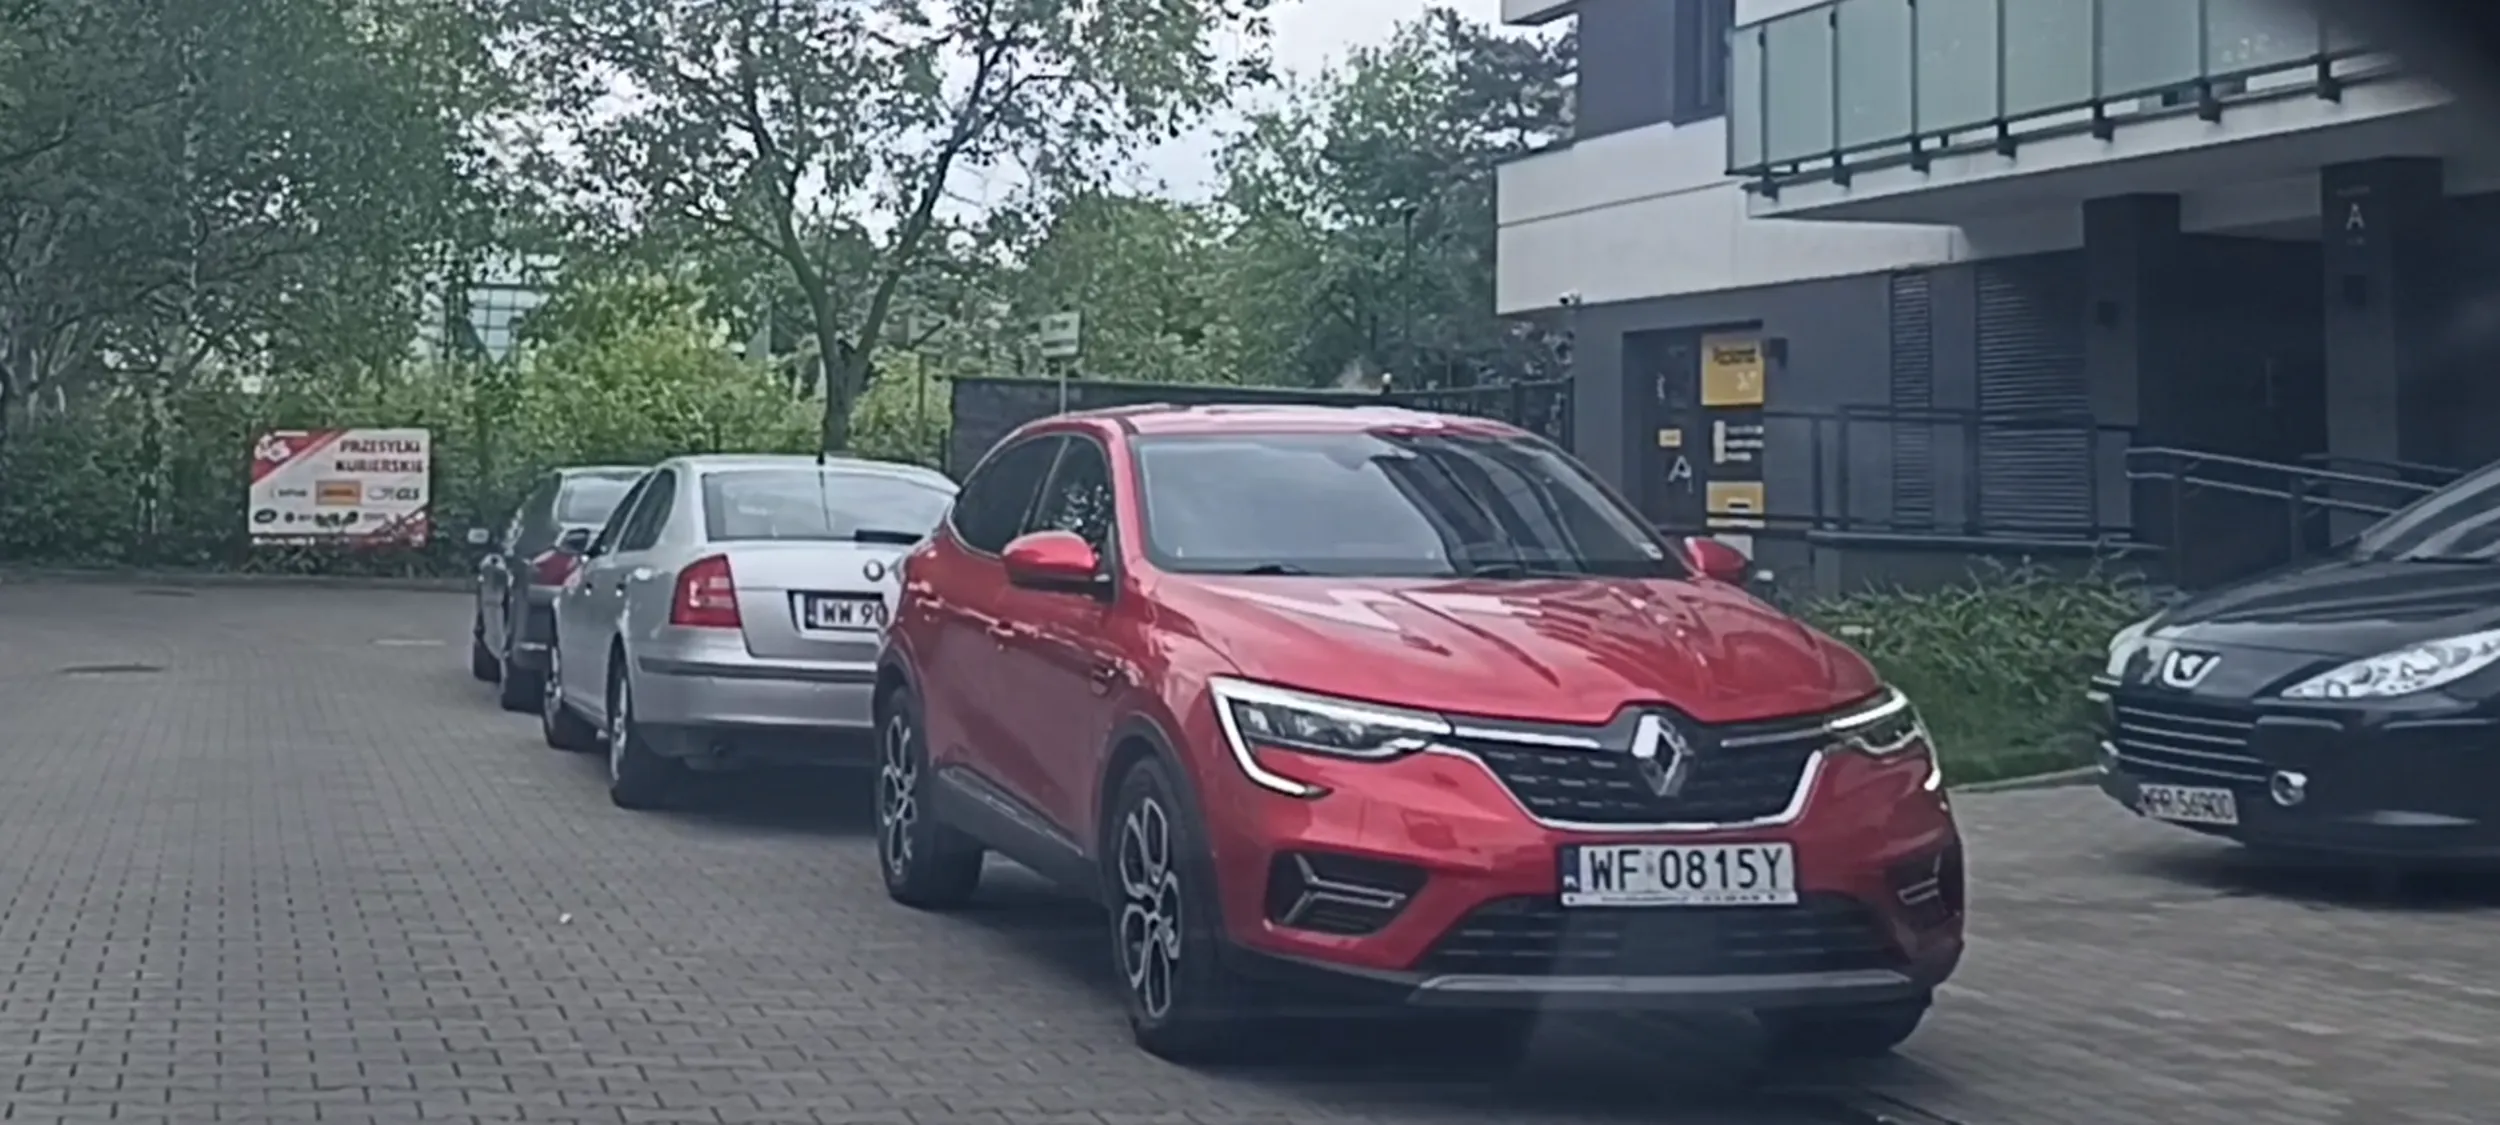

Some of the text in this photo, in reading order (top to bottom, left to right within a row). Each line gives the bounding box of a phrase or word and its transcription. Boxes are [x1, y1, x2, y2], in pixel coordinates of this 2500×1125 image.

[2346, 203, 2365, 230] A
[823, 602, 853, 624] WW
[1589, 847, 1783, 891] WF 0815Y
